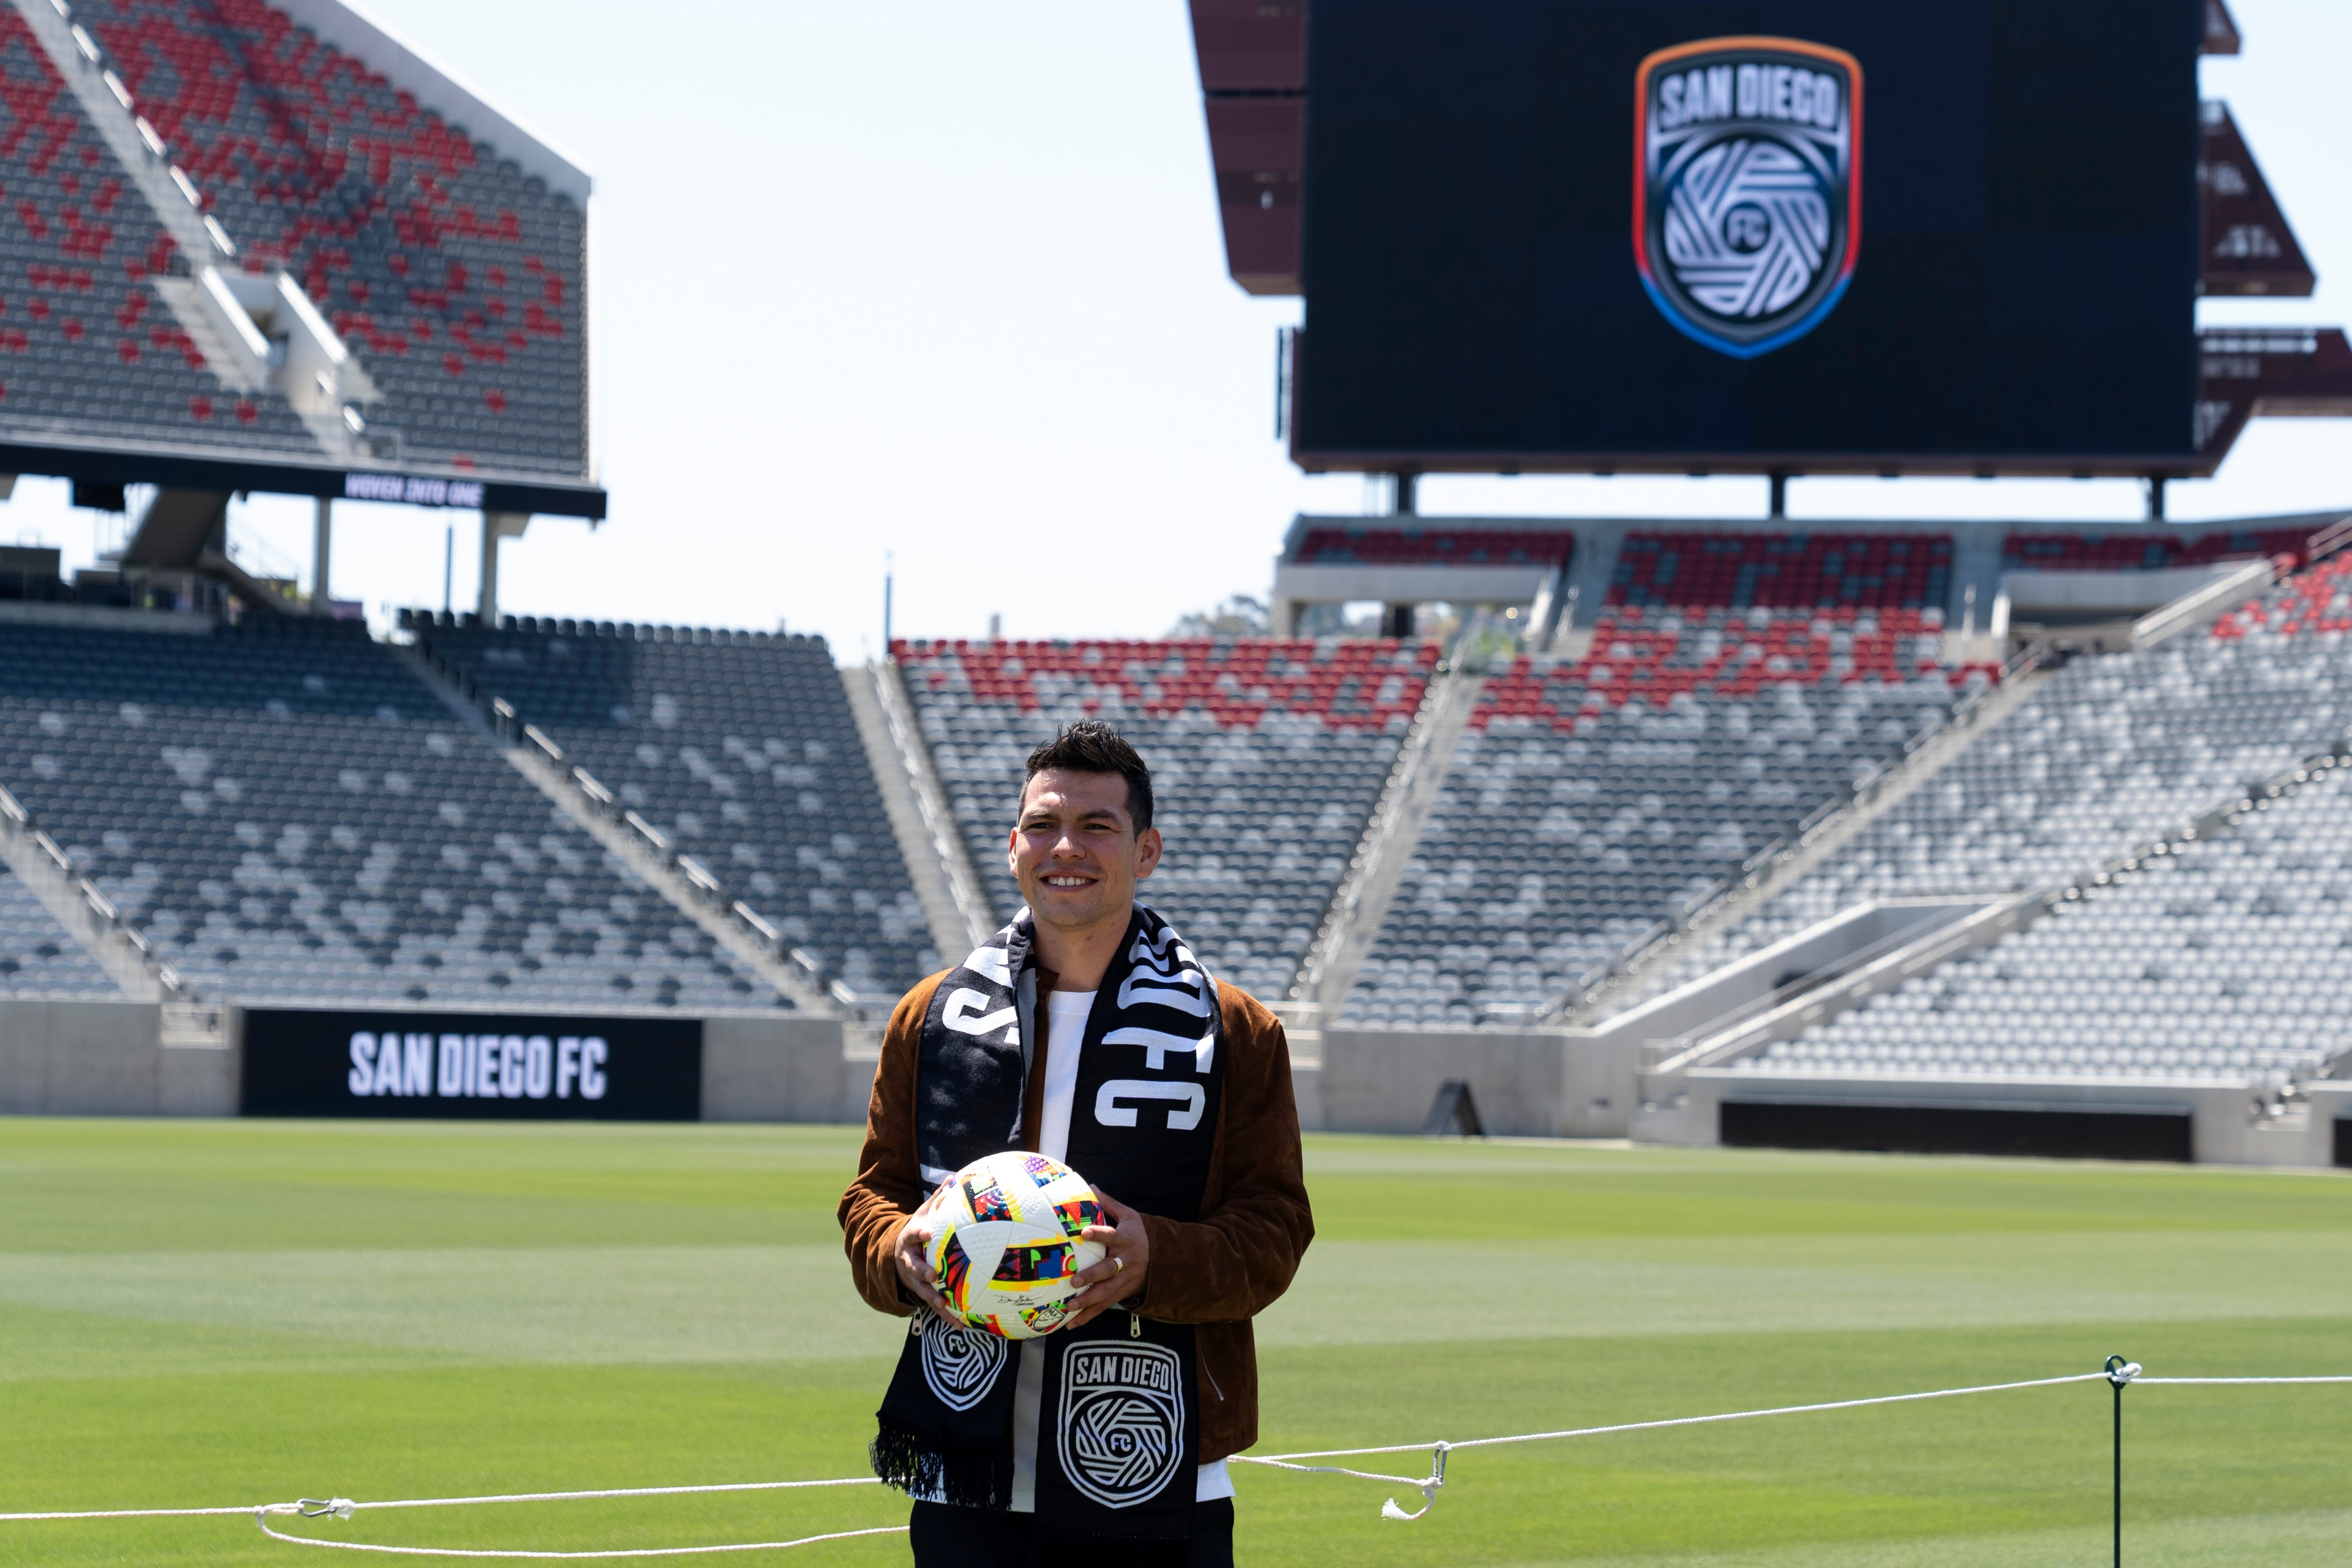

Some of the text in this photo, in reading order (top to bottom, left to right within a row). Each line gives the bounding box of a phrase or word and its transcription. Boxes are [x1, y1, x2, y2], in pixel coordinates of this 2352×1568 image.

[1661, 64, 1838, 128] SAN DIEGO
[345, 472, 483, 507] WOVEN INTO ONE
[348, 1031, 608, 1100] SAN DIEGO FC
[1094, 1027, 1215, 1131] FC
[949, 1335, 966, 1353] FC
[1076, 1356, 1169, 1391] SAN DIEGO
[1110, 1433, 1131, 1452] FC
